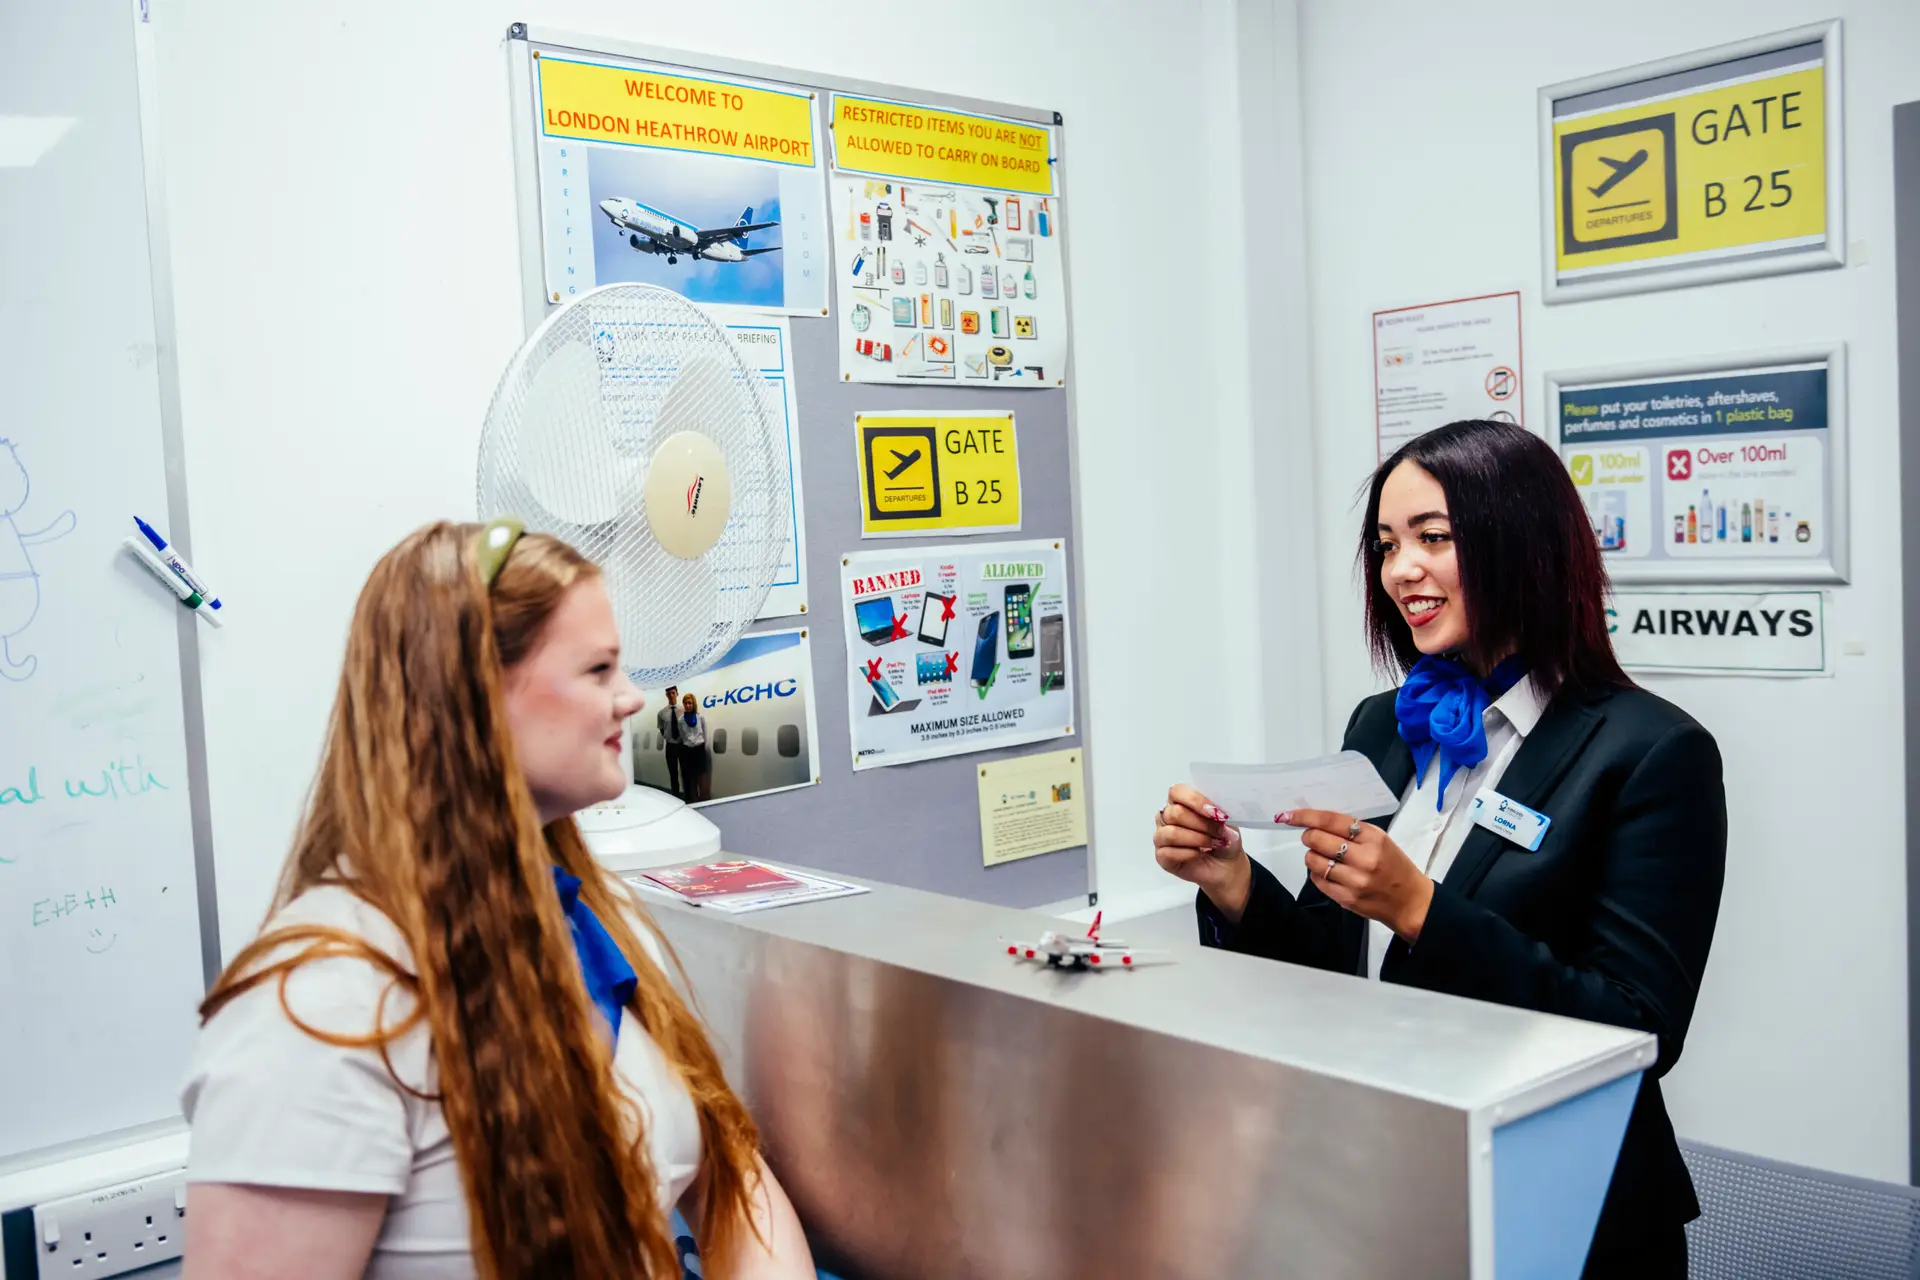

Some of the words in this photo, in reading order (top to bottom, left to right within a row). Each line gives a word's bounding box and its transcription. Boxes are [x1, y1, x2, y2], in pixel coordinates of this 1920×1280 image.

[624, 79, 717, 107] WELCOME
[721, 93, 743, 110] TO
[843, 105, 923, 130] RESTRICTED
[927, 117, 965, 136] ITEMS
[968, 124, 992, 141] YOU
[995, 129, 1017, 144] ARE
[1019, 133, 1041, 149] NOT
[1691, 91, 1802, 146] GATE
[548, 108, 630, 134] LONDON
[636, 119, 738, 147] HEATHROW
[743, 133, 809, 157] AIRPORT
[847, 135, 912, 156] ALLOWED
[916, 144, 934, 160] TO
[938, 147, 977, 164] CARRY
[981, 153, 998, 168] ON
[1002, 156, 1040, 173] BOARD
[1704, 182, 1727, 218] B
[1743, 170, 1792, 212] 25
[1586, 211, 1653, 229] DEPARTURES
[738, 333, 777, 344] BRIEFING
[1564, 403, 1599, 417] Please
[1601, 401, 1621, 418] put
[1622, 401, 1649, 417] your
[1651, 395, 1704, 411] toiletries,
[1707, 390, 1779, 407] aftershaves,
[1564, 418, 1616, 436] perfumes
[1618, 415, 1640, 430] and
[1642, 410, 1698, 428] cosmetics
[1701, 410, 1712, 423] in
[1716, 410, 1722, 423] 1
[1726, 407, 1765, 425] plastic
[1768, 405, 1794, 423] bag
[945, 430, 1004, 454] GATE
[1697, 448, 1735, 465] Over
[1740, 443, 1787, 463] 100ml
[1599, 452, 1640, 470] 100ml
[691, 477, 703, 514] Levante
[884, 494, 926, 503] DEPARTURES
[955, 481, 969, 505] B
[977, 480, 1002, 504] 25
[853, 570, 921, 595] BANNED
[983, 563, 1043, 578] ALLOWED
[1631, 609, 1814, 637] AIRWAYS
[702, 678, 797, 709] G-KCHC
[911, 717, 958, 734] MAXIMUM
[960, 714, 979, 726] SIZE
[981, 708, 1025, 723] ALLOWED
[931, 732, 948, 740] inches
[65, 754, 169, 800] with
[1494, 815, 1517, 831] LORNA
